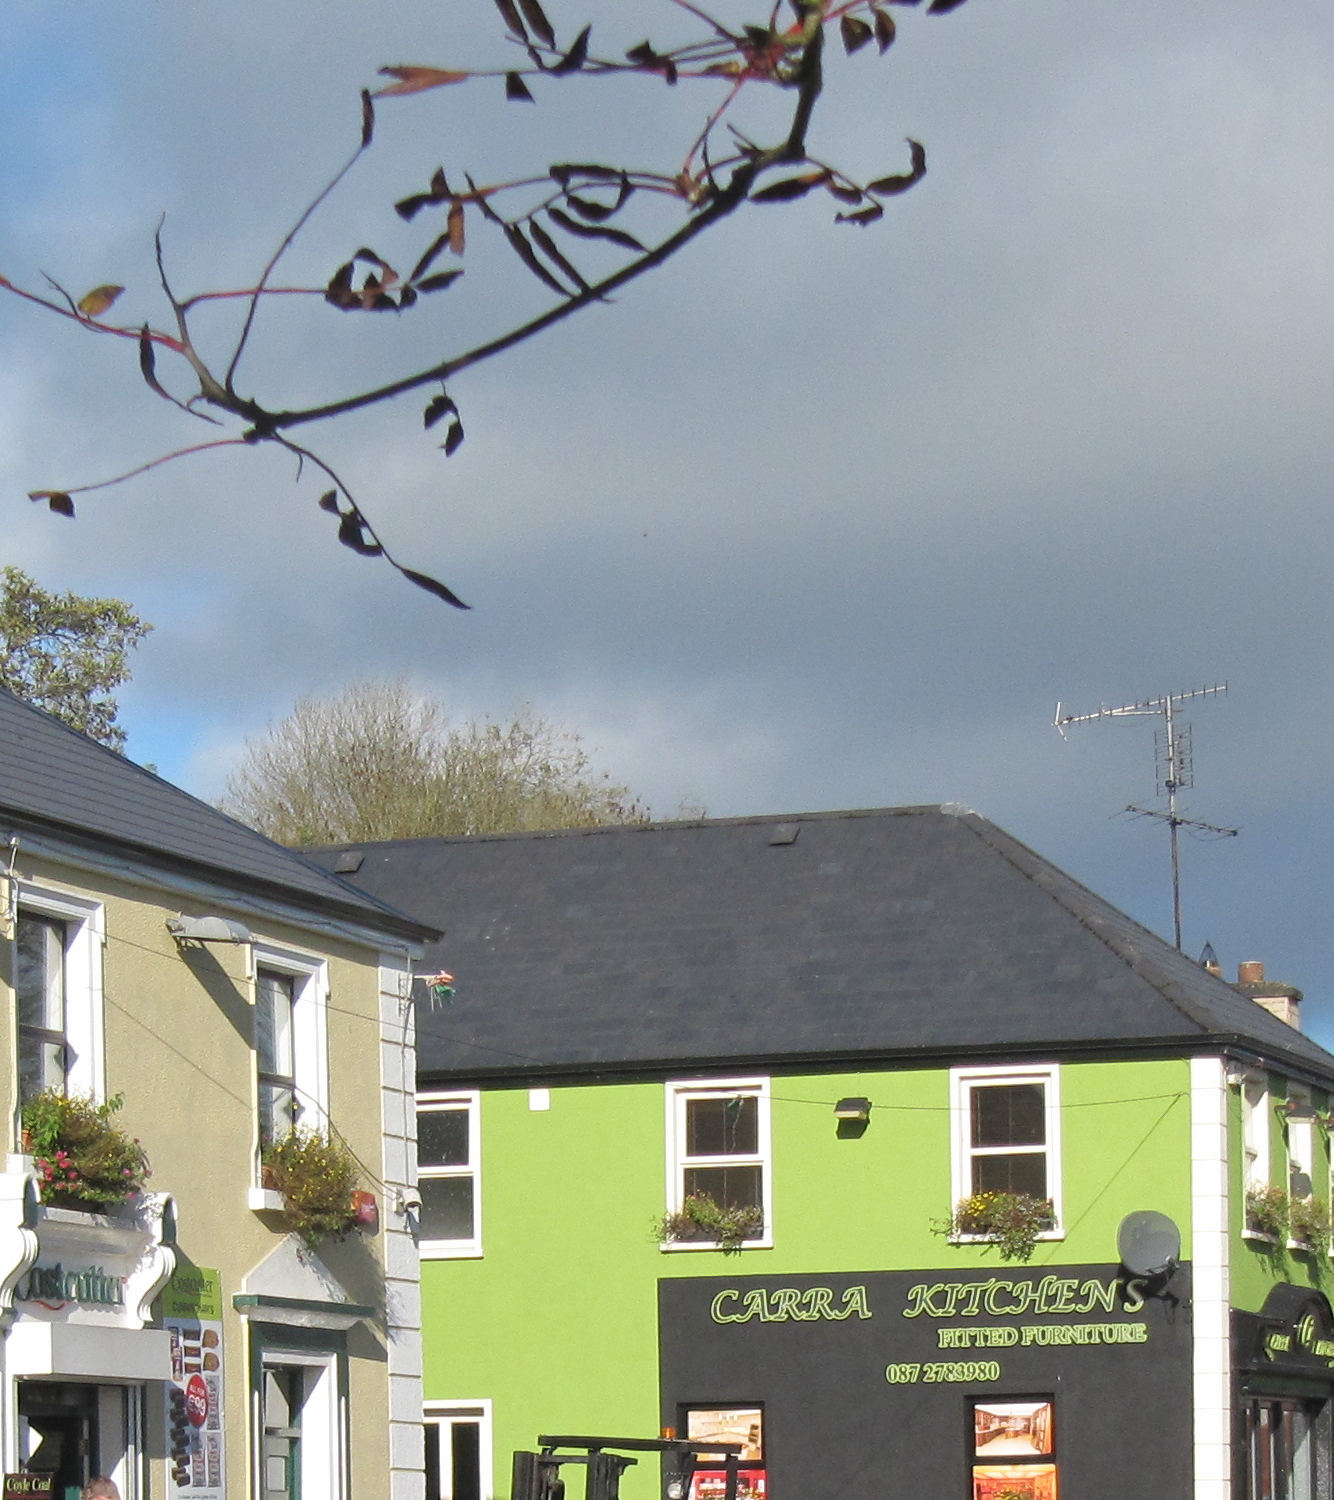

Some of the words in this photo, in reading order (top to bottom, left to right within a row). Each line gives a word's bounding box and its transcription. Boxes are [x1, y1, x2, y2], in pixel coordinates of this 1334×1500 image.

[711, 1286, 873, 1324] CARRA
[938, 1327, 1019, 1348] FITTED
[1020, 1323, 1148, 1346] FURNITURE
[886, 1364, 920, 1383] 087
